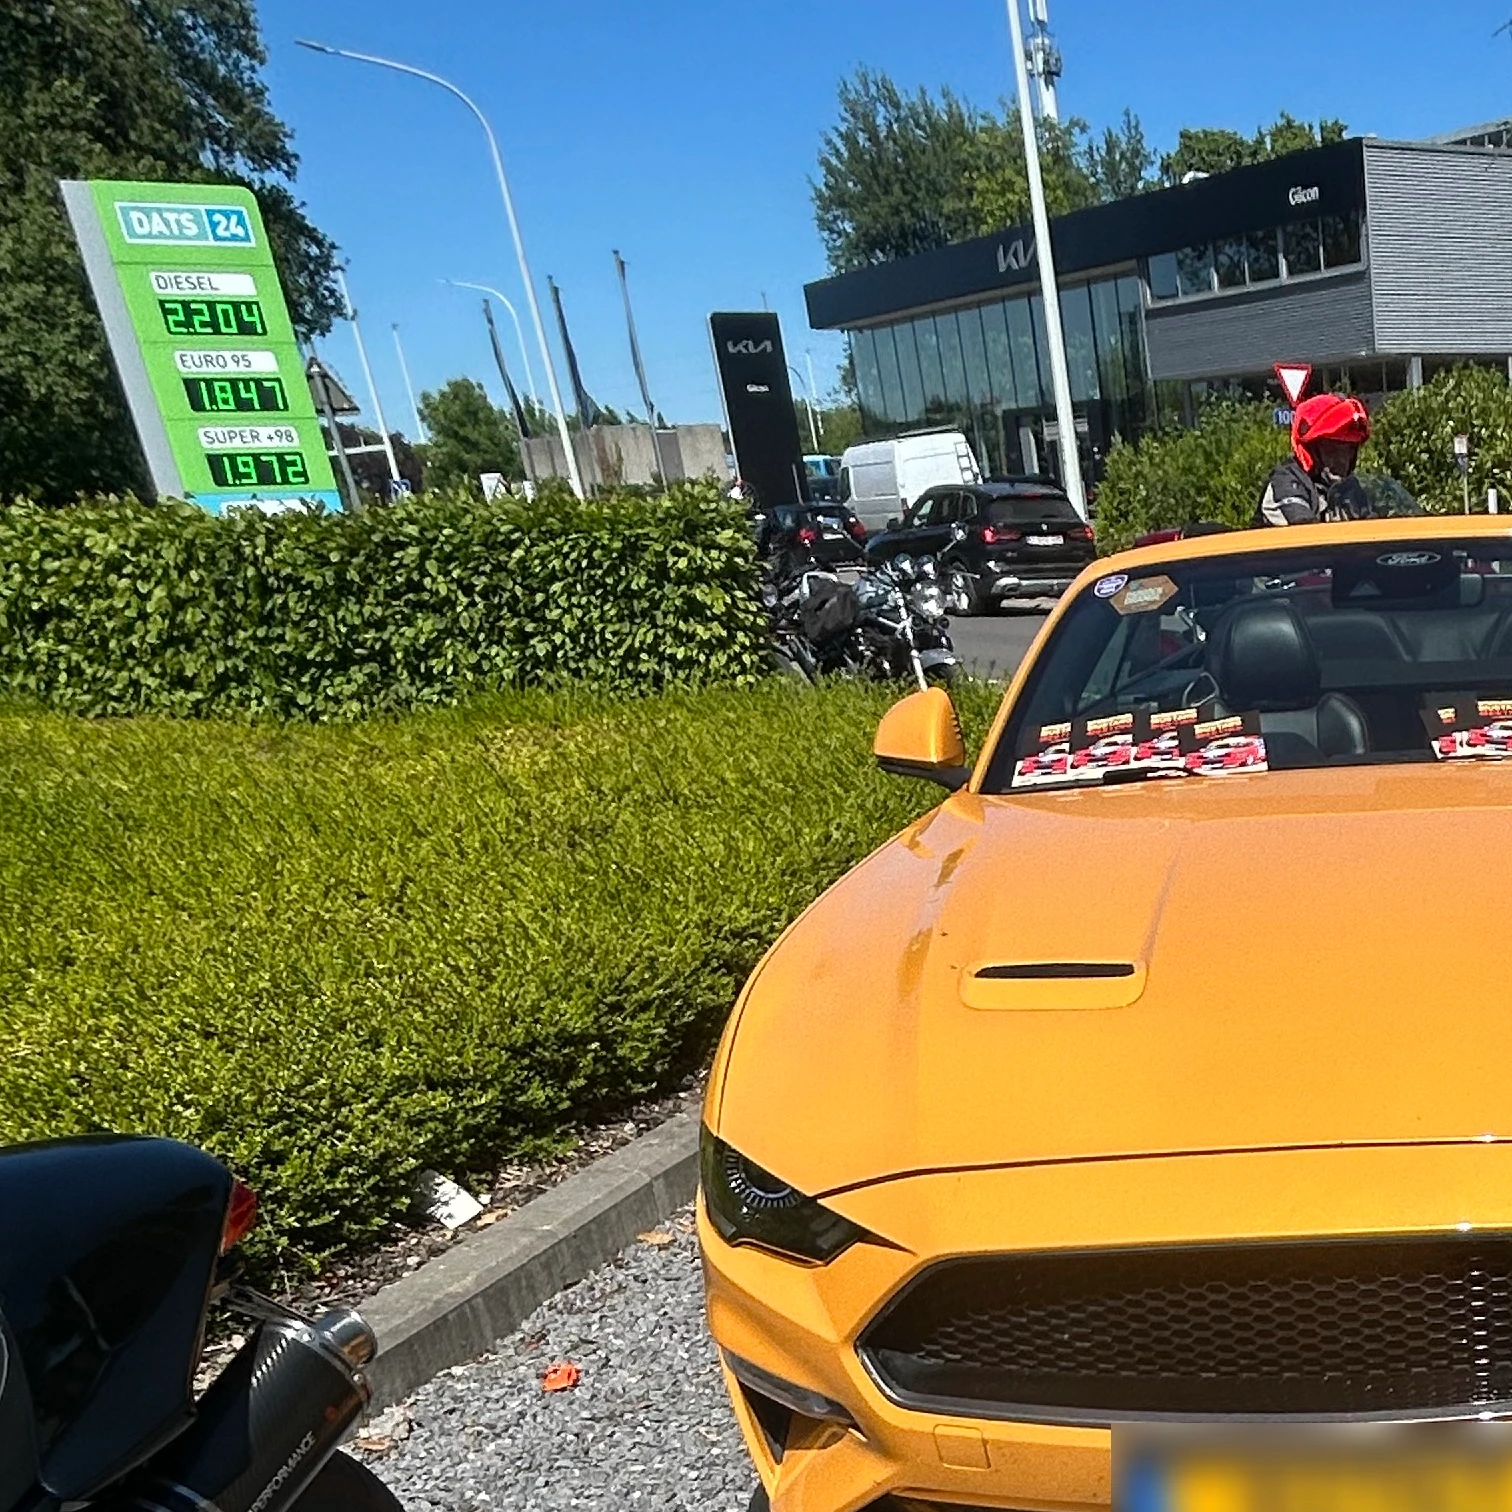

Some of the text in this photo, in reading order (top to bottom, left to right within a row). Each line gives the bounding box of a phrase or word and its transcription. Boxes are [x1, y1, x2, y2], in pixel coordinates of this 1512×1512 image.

[129, 210, 246, 237] DATS 24
[155, 274, 221, 291] DIESEL
[164, 303, 263, 333] 2.204
[727, 340, 773, 353] KIA
[180, 353, 252, 369] EURO 95
[199, 381, 285, 410] 1.847
[203, 429, 262, 444] SUPER
[222, 455, 308, 484] 1.972
